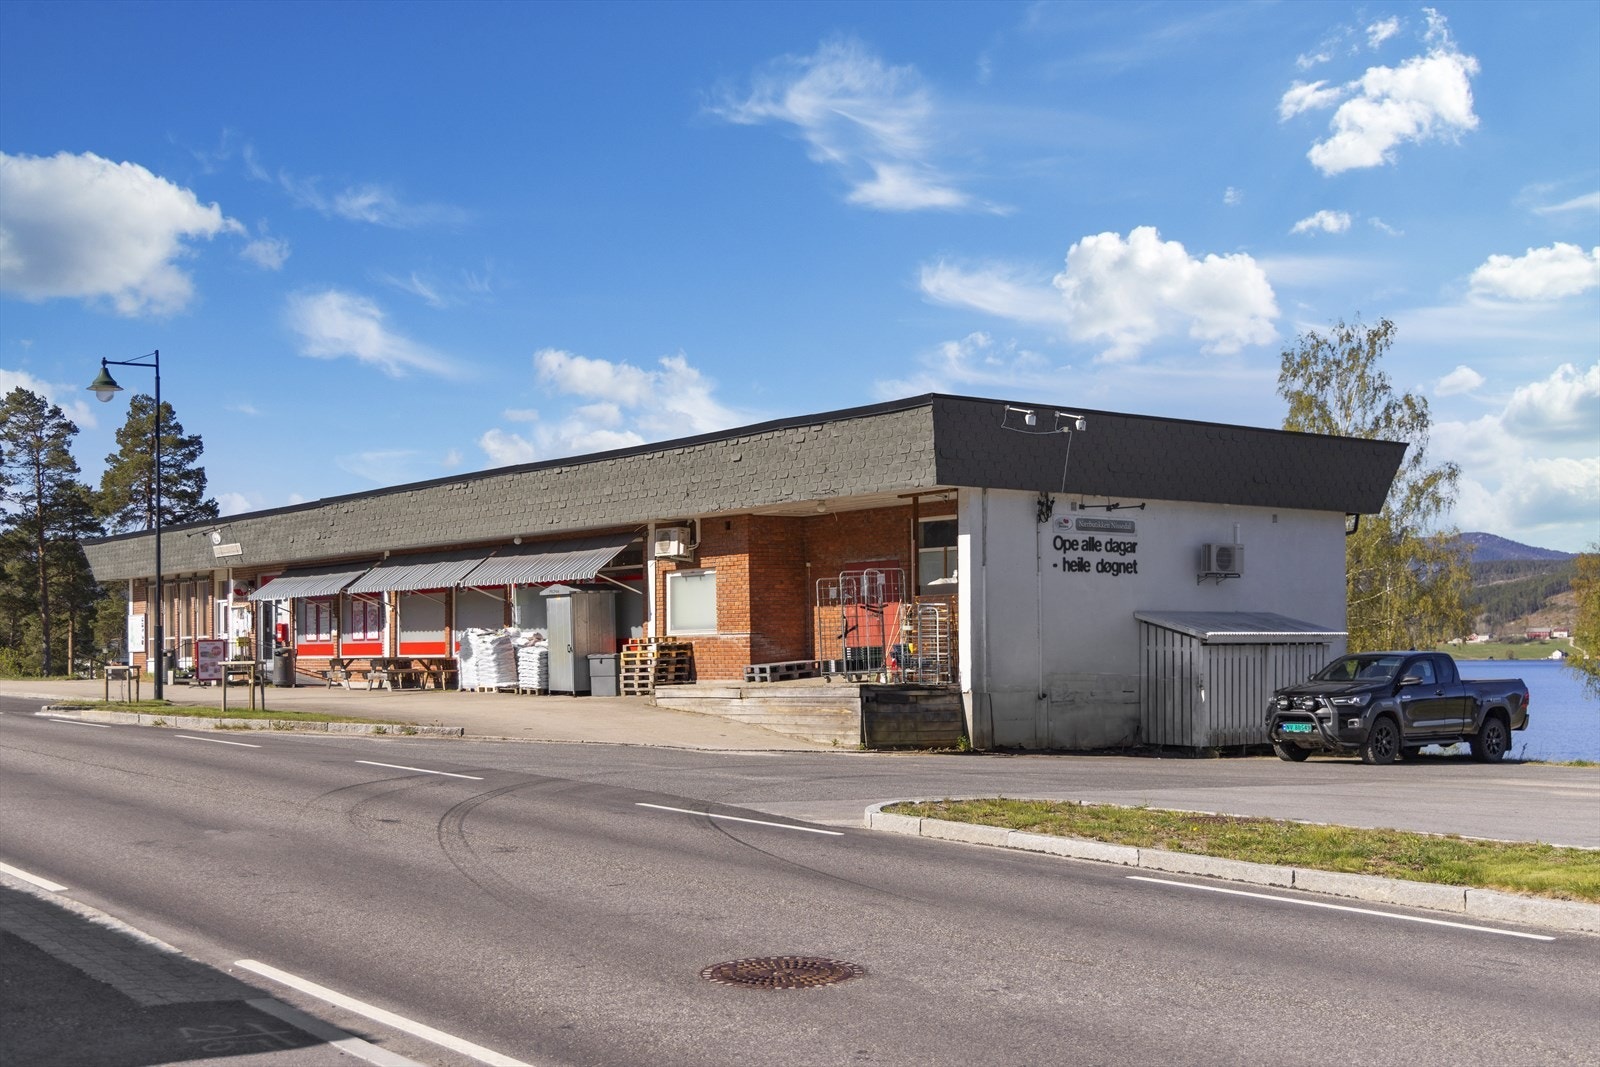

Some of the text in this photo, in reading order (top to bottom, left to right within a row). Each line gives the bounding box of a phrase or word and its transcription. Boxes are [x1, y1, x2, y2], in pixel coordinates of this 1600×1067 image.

[1053, 535, 1138, 556] Ope alle dagar
[1062, 557, 1091, 572] heile
[1096, 558, 1138, 577] døgnet
